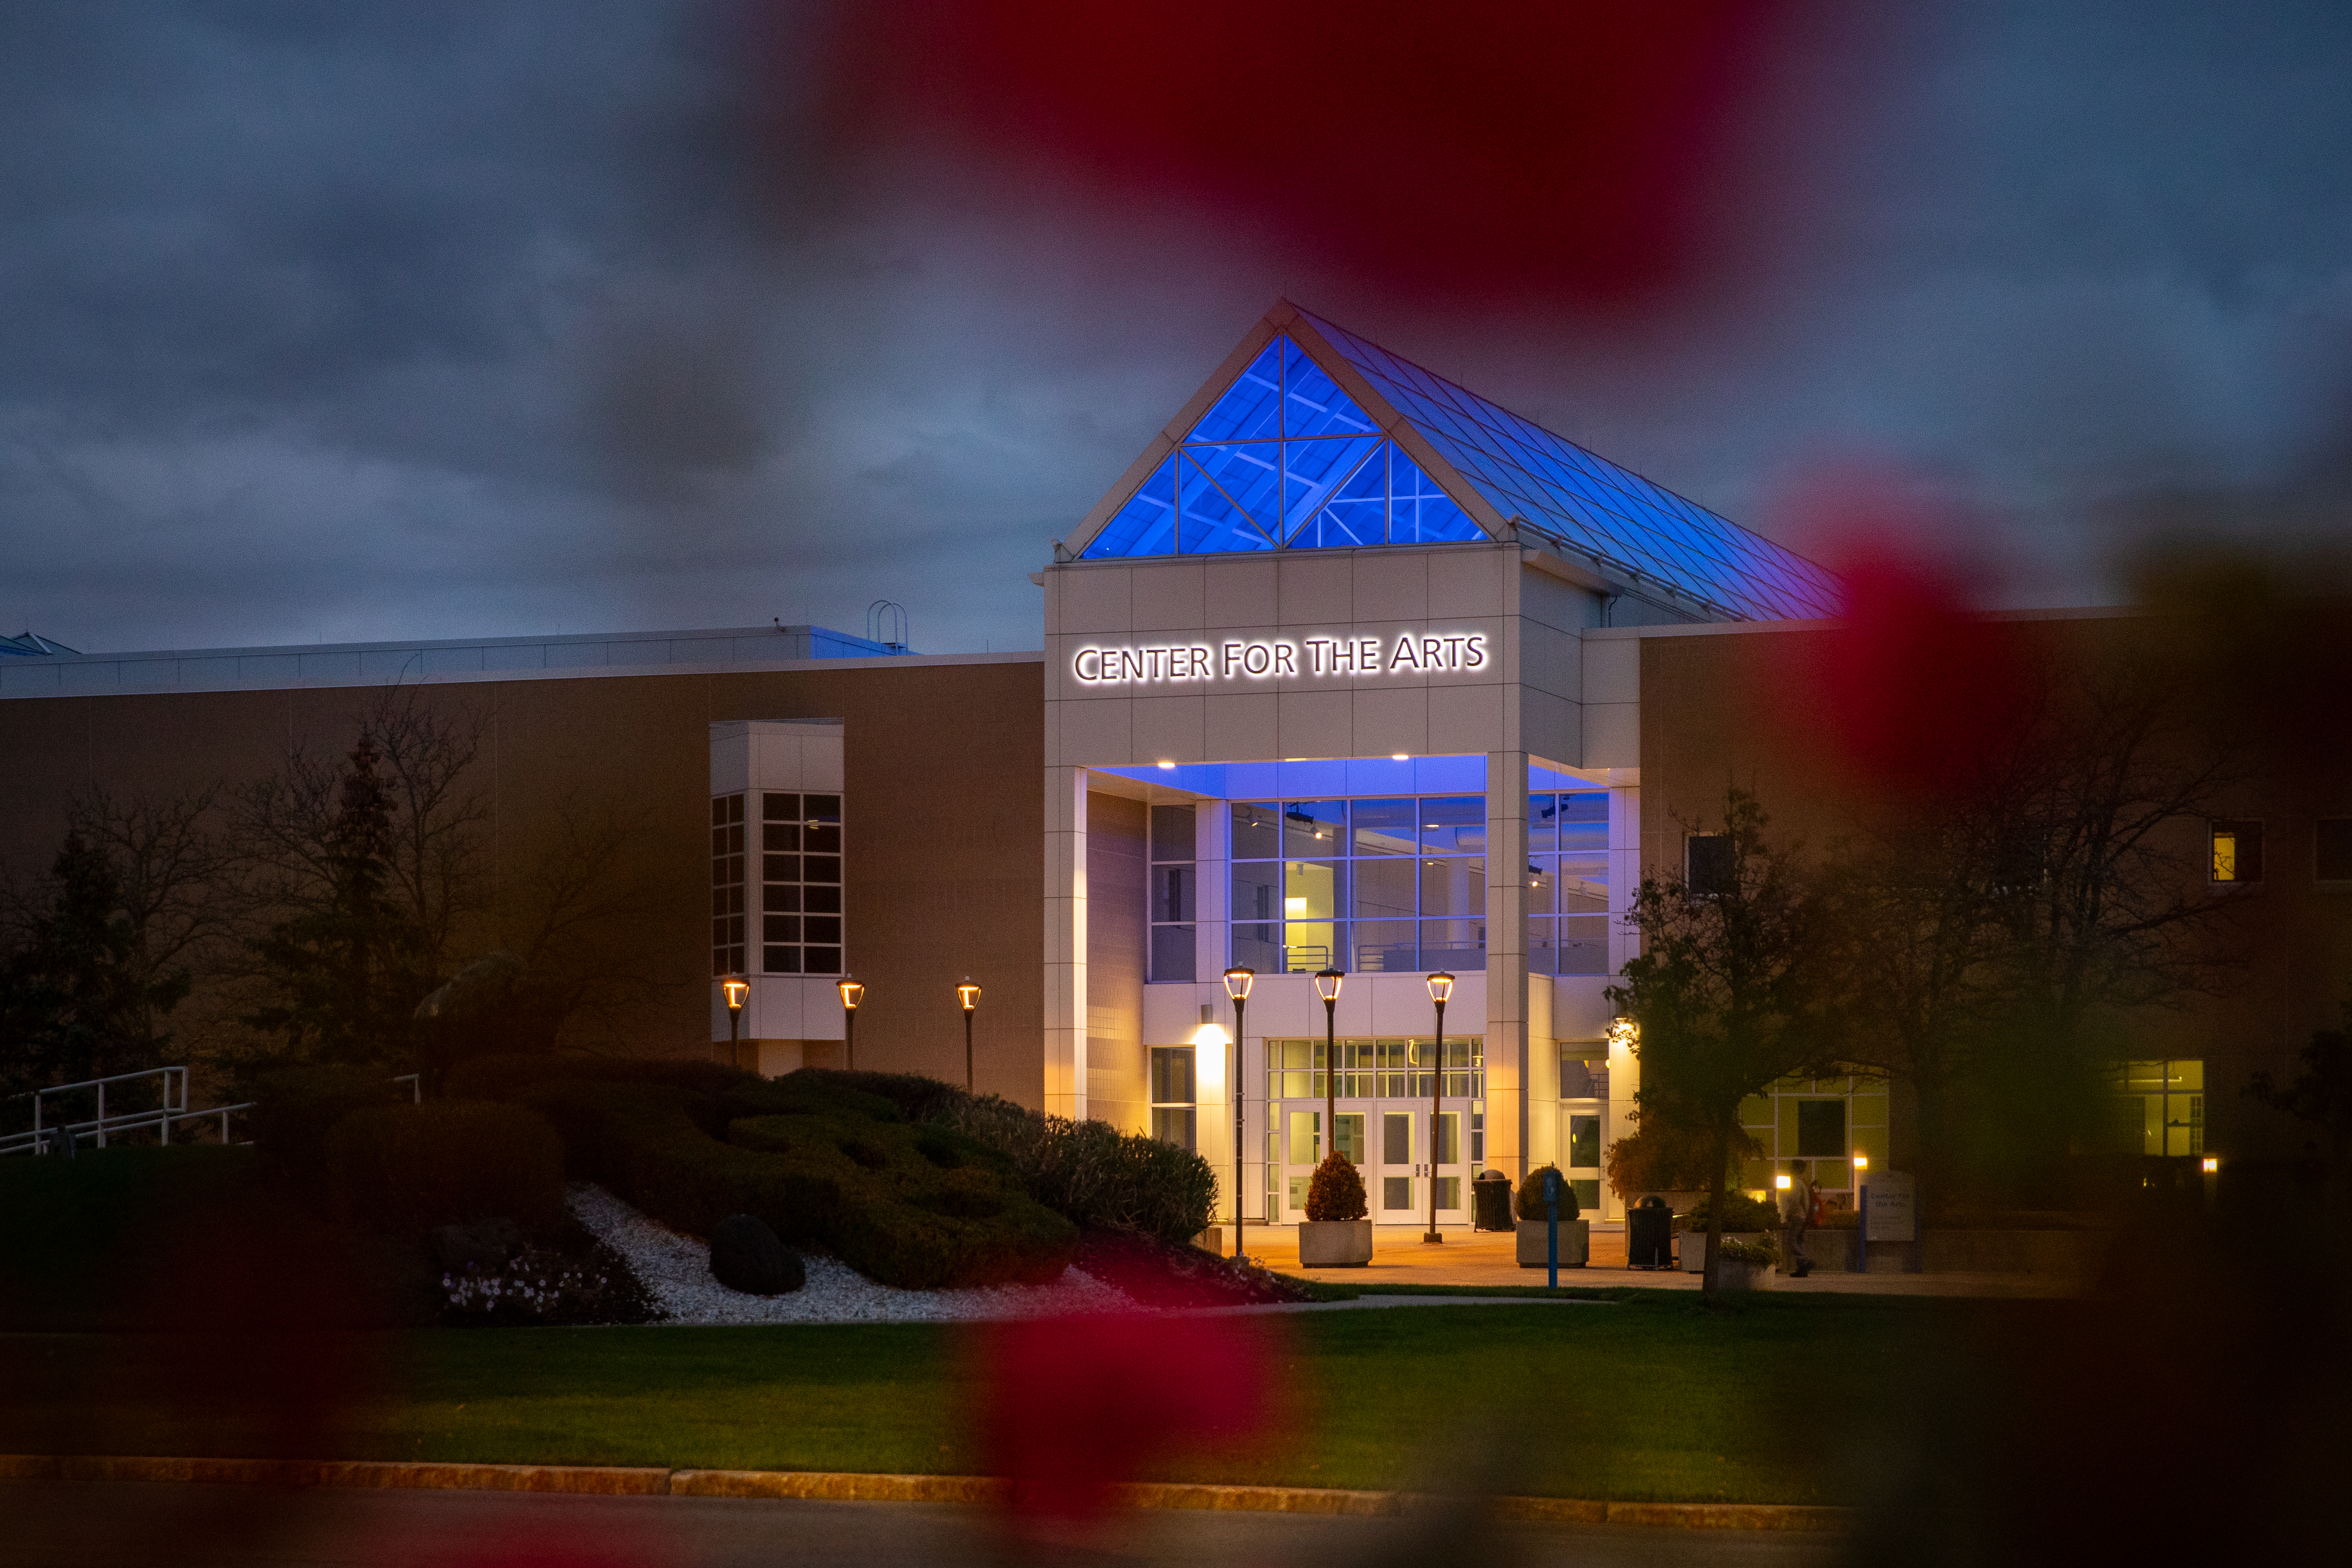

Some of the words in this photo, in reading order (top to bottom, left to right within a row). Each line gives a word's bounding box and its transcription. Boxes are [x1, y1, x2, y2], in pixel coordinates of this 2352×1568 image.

[1075, 648, 1210, 680] CENTER
[1225, 643, 1295, 674] FOR
[1306, 640, 1377, 672] THE
[1390, 637, 1483, 669] ARTS
